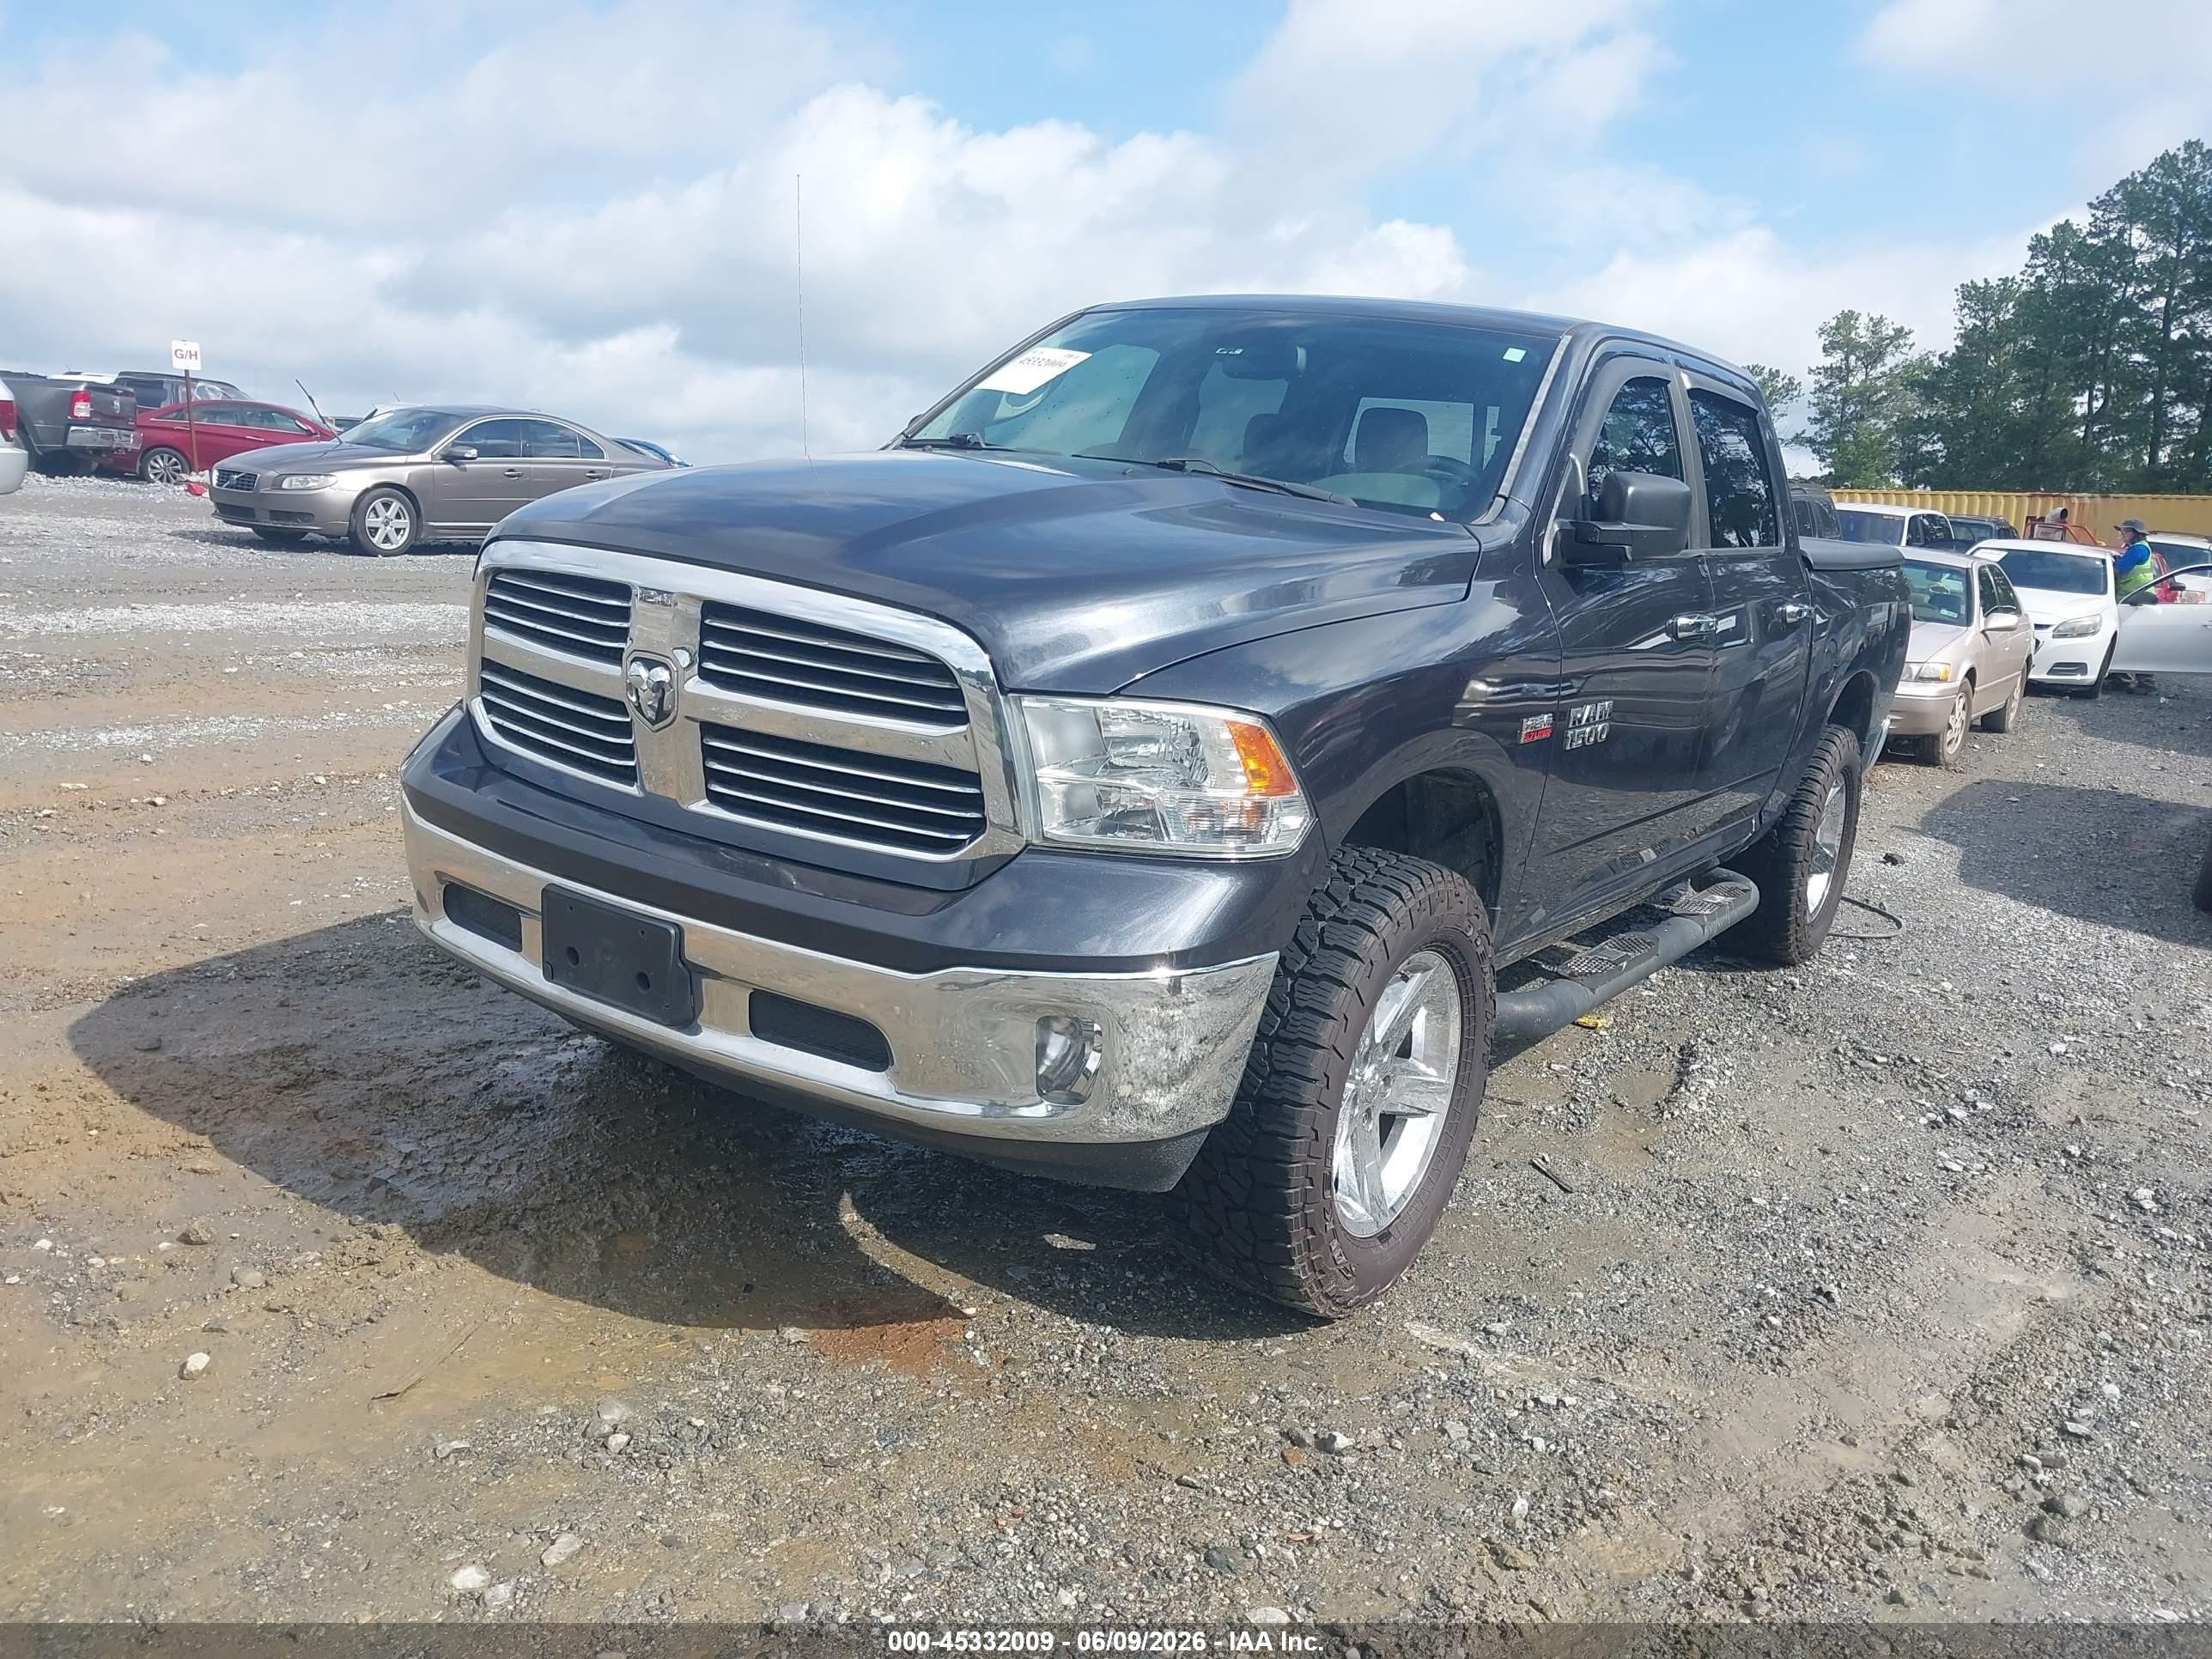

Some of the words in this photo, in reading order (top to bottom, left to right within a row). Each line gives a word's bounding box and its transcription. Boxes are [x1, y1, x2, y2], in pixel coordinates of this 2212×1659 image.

[174, 349, 198, 361] G/H
[1567, 701, 1613, 728] RAM
[1565, 723, 1610, 750] 1500
